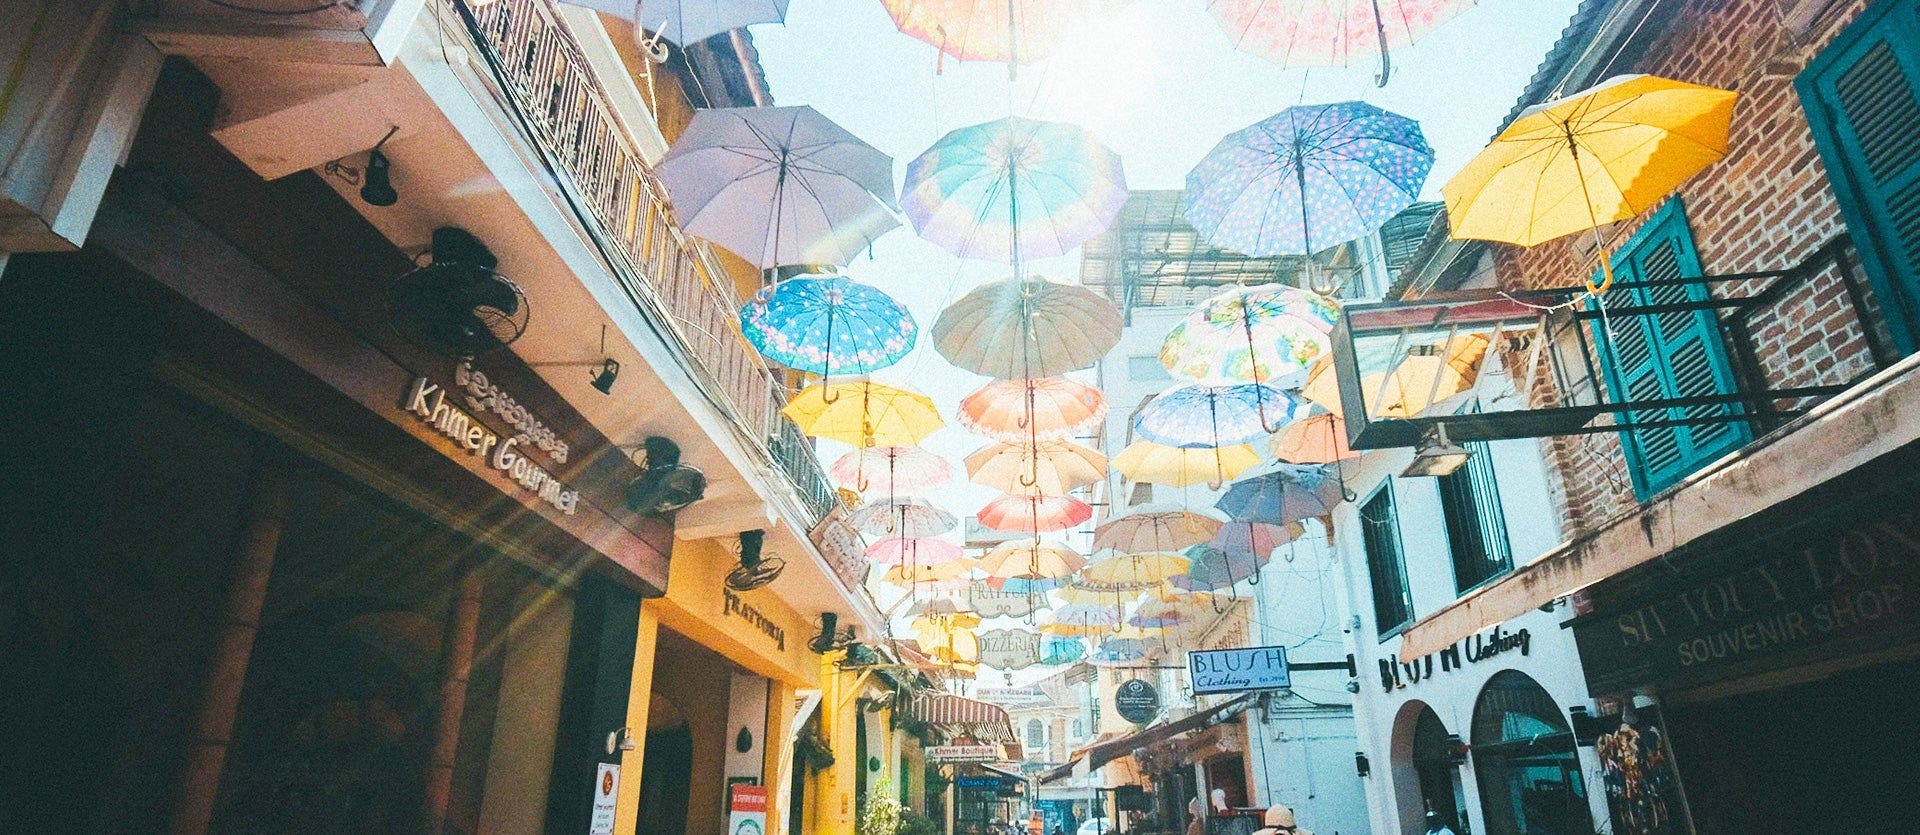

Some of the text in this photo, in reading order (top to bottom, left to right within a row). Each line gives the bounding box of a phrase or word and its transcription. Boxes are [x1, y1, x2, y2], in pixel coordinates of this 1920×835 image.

[405, 377, 497, 457] Khmer
[494, 437, 580, 515] Gourmet
[723, 587, 785, 652] TRATTORIA
[1677, 583, 1903, 667] SOUVENIR SHOP
[980, 635, 1037, 658] PIZZERIA
[1193, 649, 1282, 673] BLUSH
[1197, 673, 1251, 687] Clothing
[935, 746, 994, 757] Khmer Boutique
